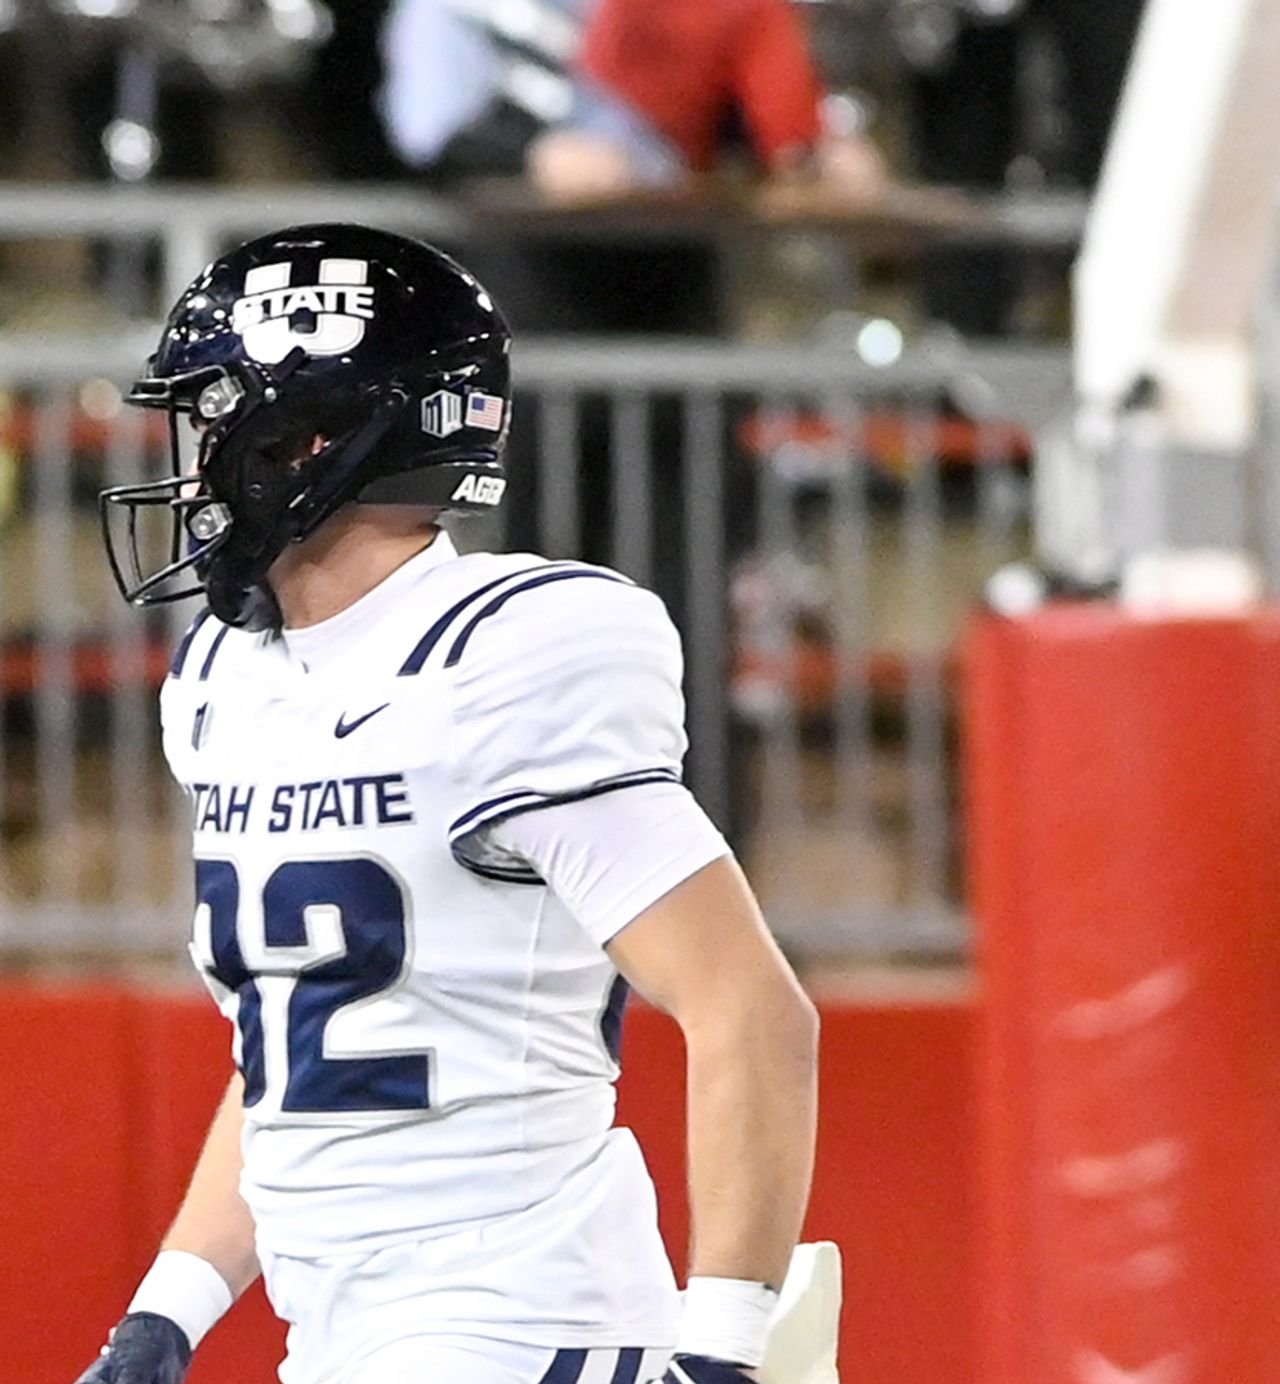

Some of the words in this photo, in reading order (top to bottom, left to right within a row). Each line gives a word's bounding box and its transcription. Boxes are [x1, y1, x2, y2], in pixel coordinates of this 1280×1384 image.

[232, 286, 375, 334] STATE
[186, 782, 255, 834] TAH
[269, 772, 414, 834] STATE
